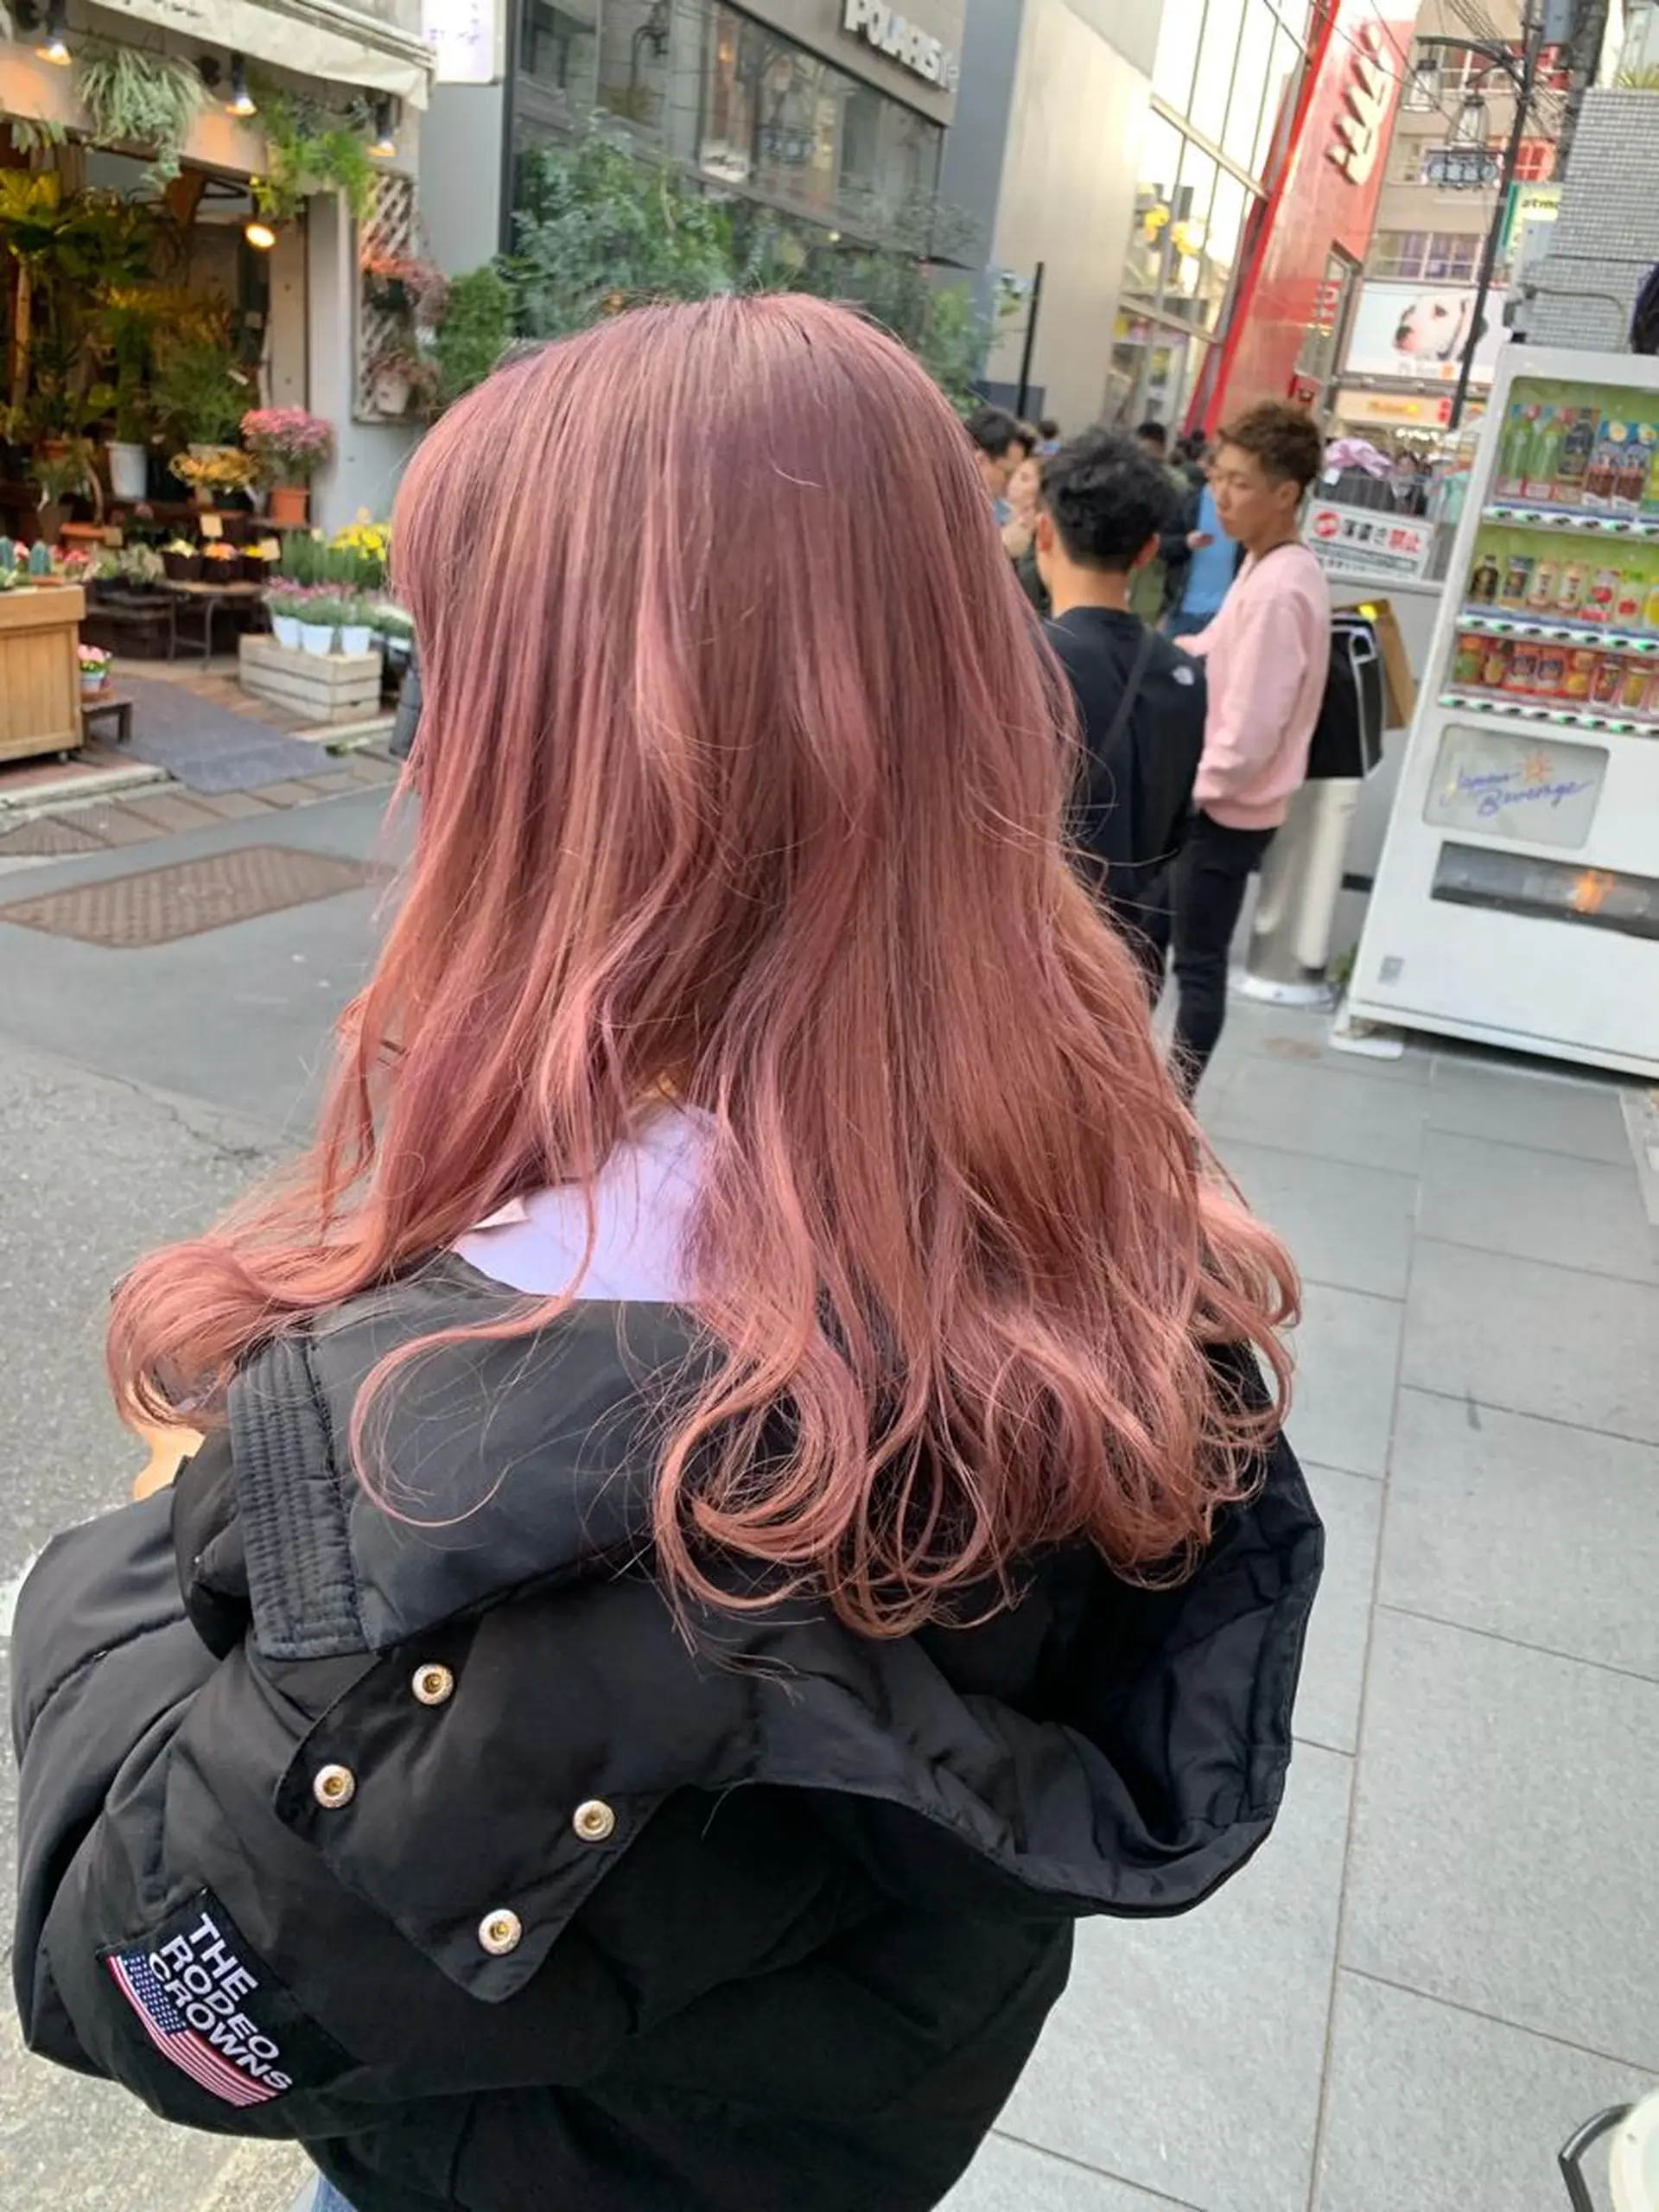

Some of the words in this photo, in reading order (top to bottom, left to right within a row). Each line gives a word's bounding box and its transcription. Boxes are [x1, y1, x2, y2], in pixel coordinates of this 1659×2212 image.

[160, 1935, 279, 2060] RODEO
[189, 1912, 258, 2001] THE
[149, 1952, 293, 2089] CROWNS
